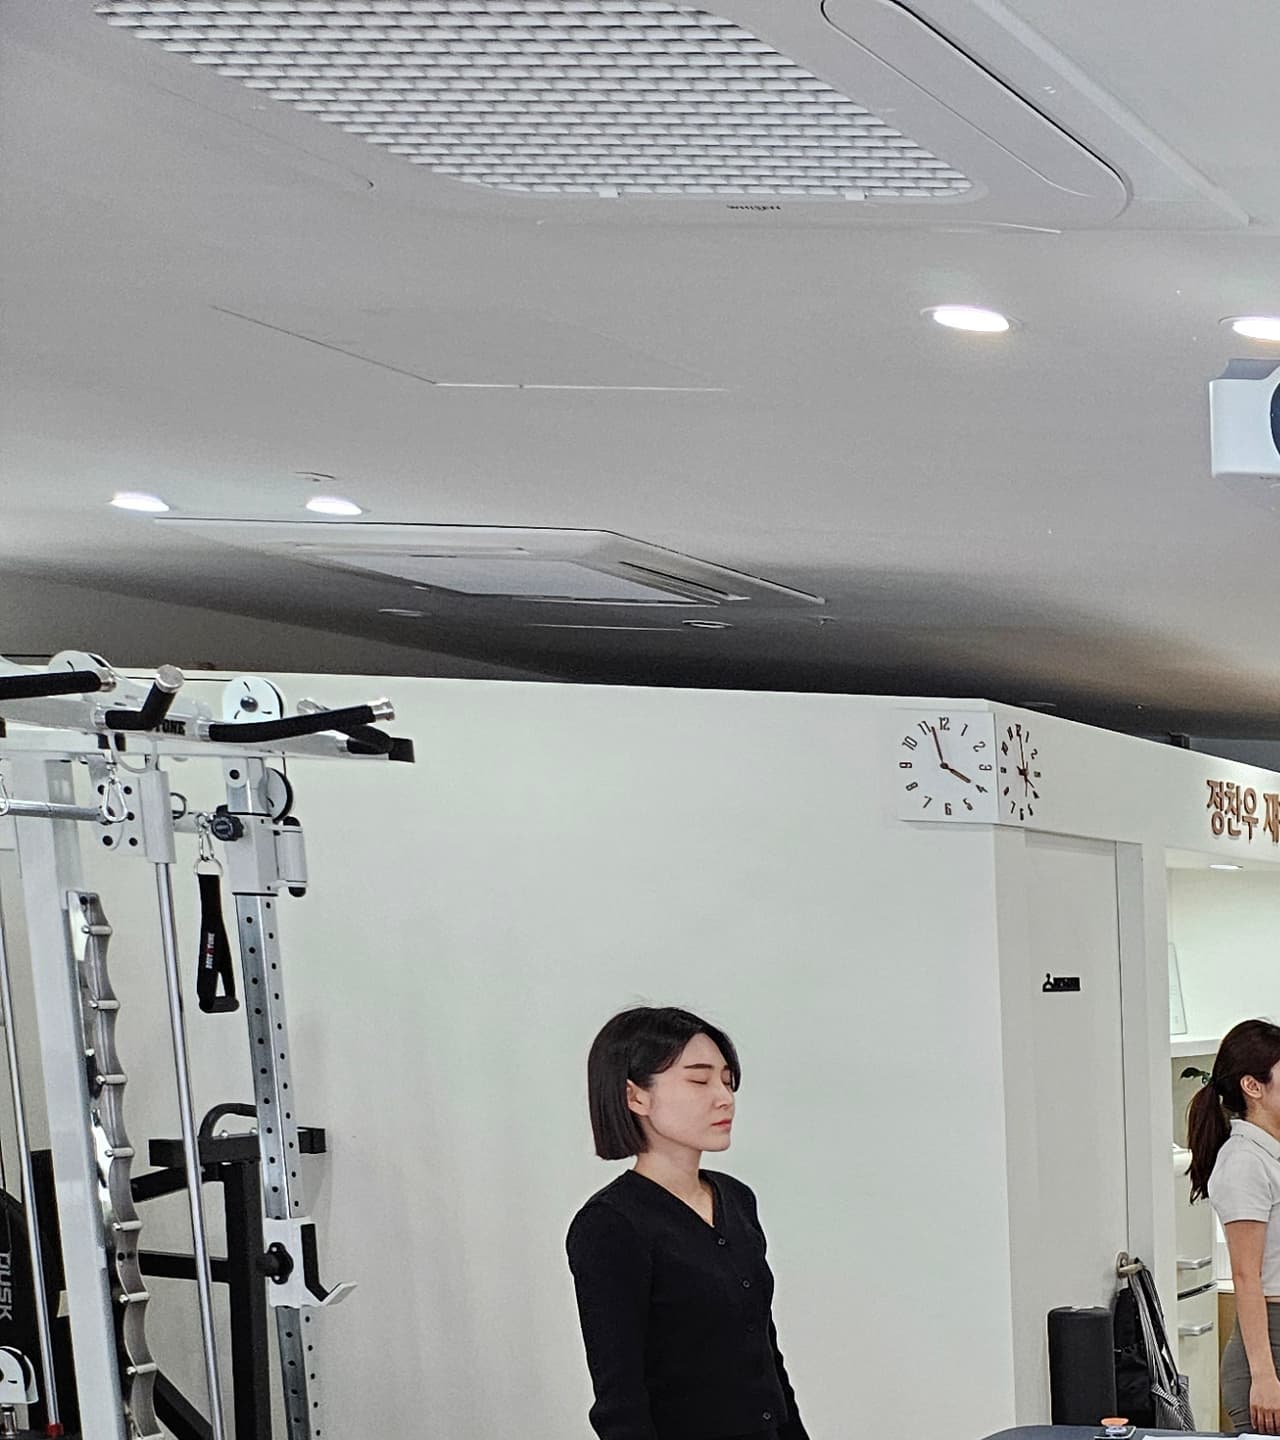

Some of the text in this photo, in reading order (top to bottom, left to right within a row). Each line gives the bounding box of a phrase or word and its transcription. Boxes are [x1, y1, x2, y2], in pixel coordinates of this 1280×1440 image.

[937, 716, 951, 731] 12
[901, 735, 919, 751] 10
[972, 741, 986, 753] 2
[898, 761, 913, 770] 9
[978, 764, 993, 772] 3
[905, 781, 919, 791] 8
[975, 784, 989, 794] 4
[922, 795, 933, 809] 7
[962, 798, 974, 811] 5
[944, 802, 953, 816] 6
[1206, 779, 1259, 841] 정찬우
